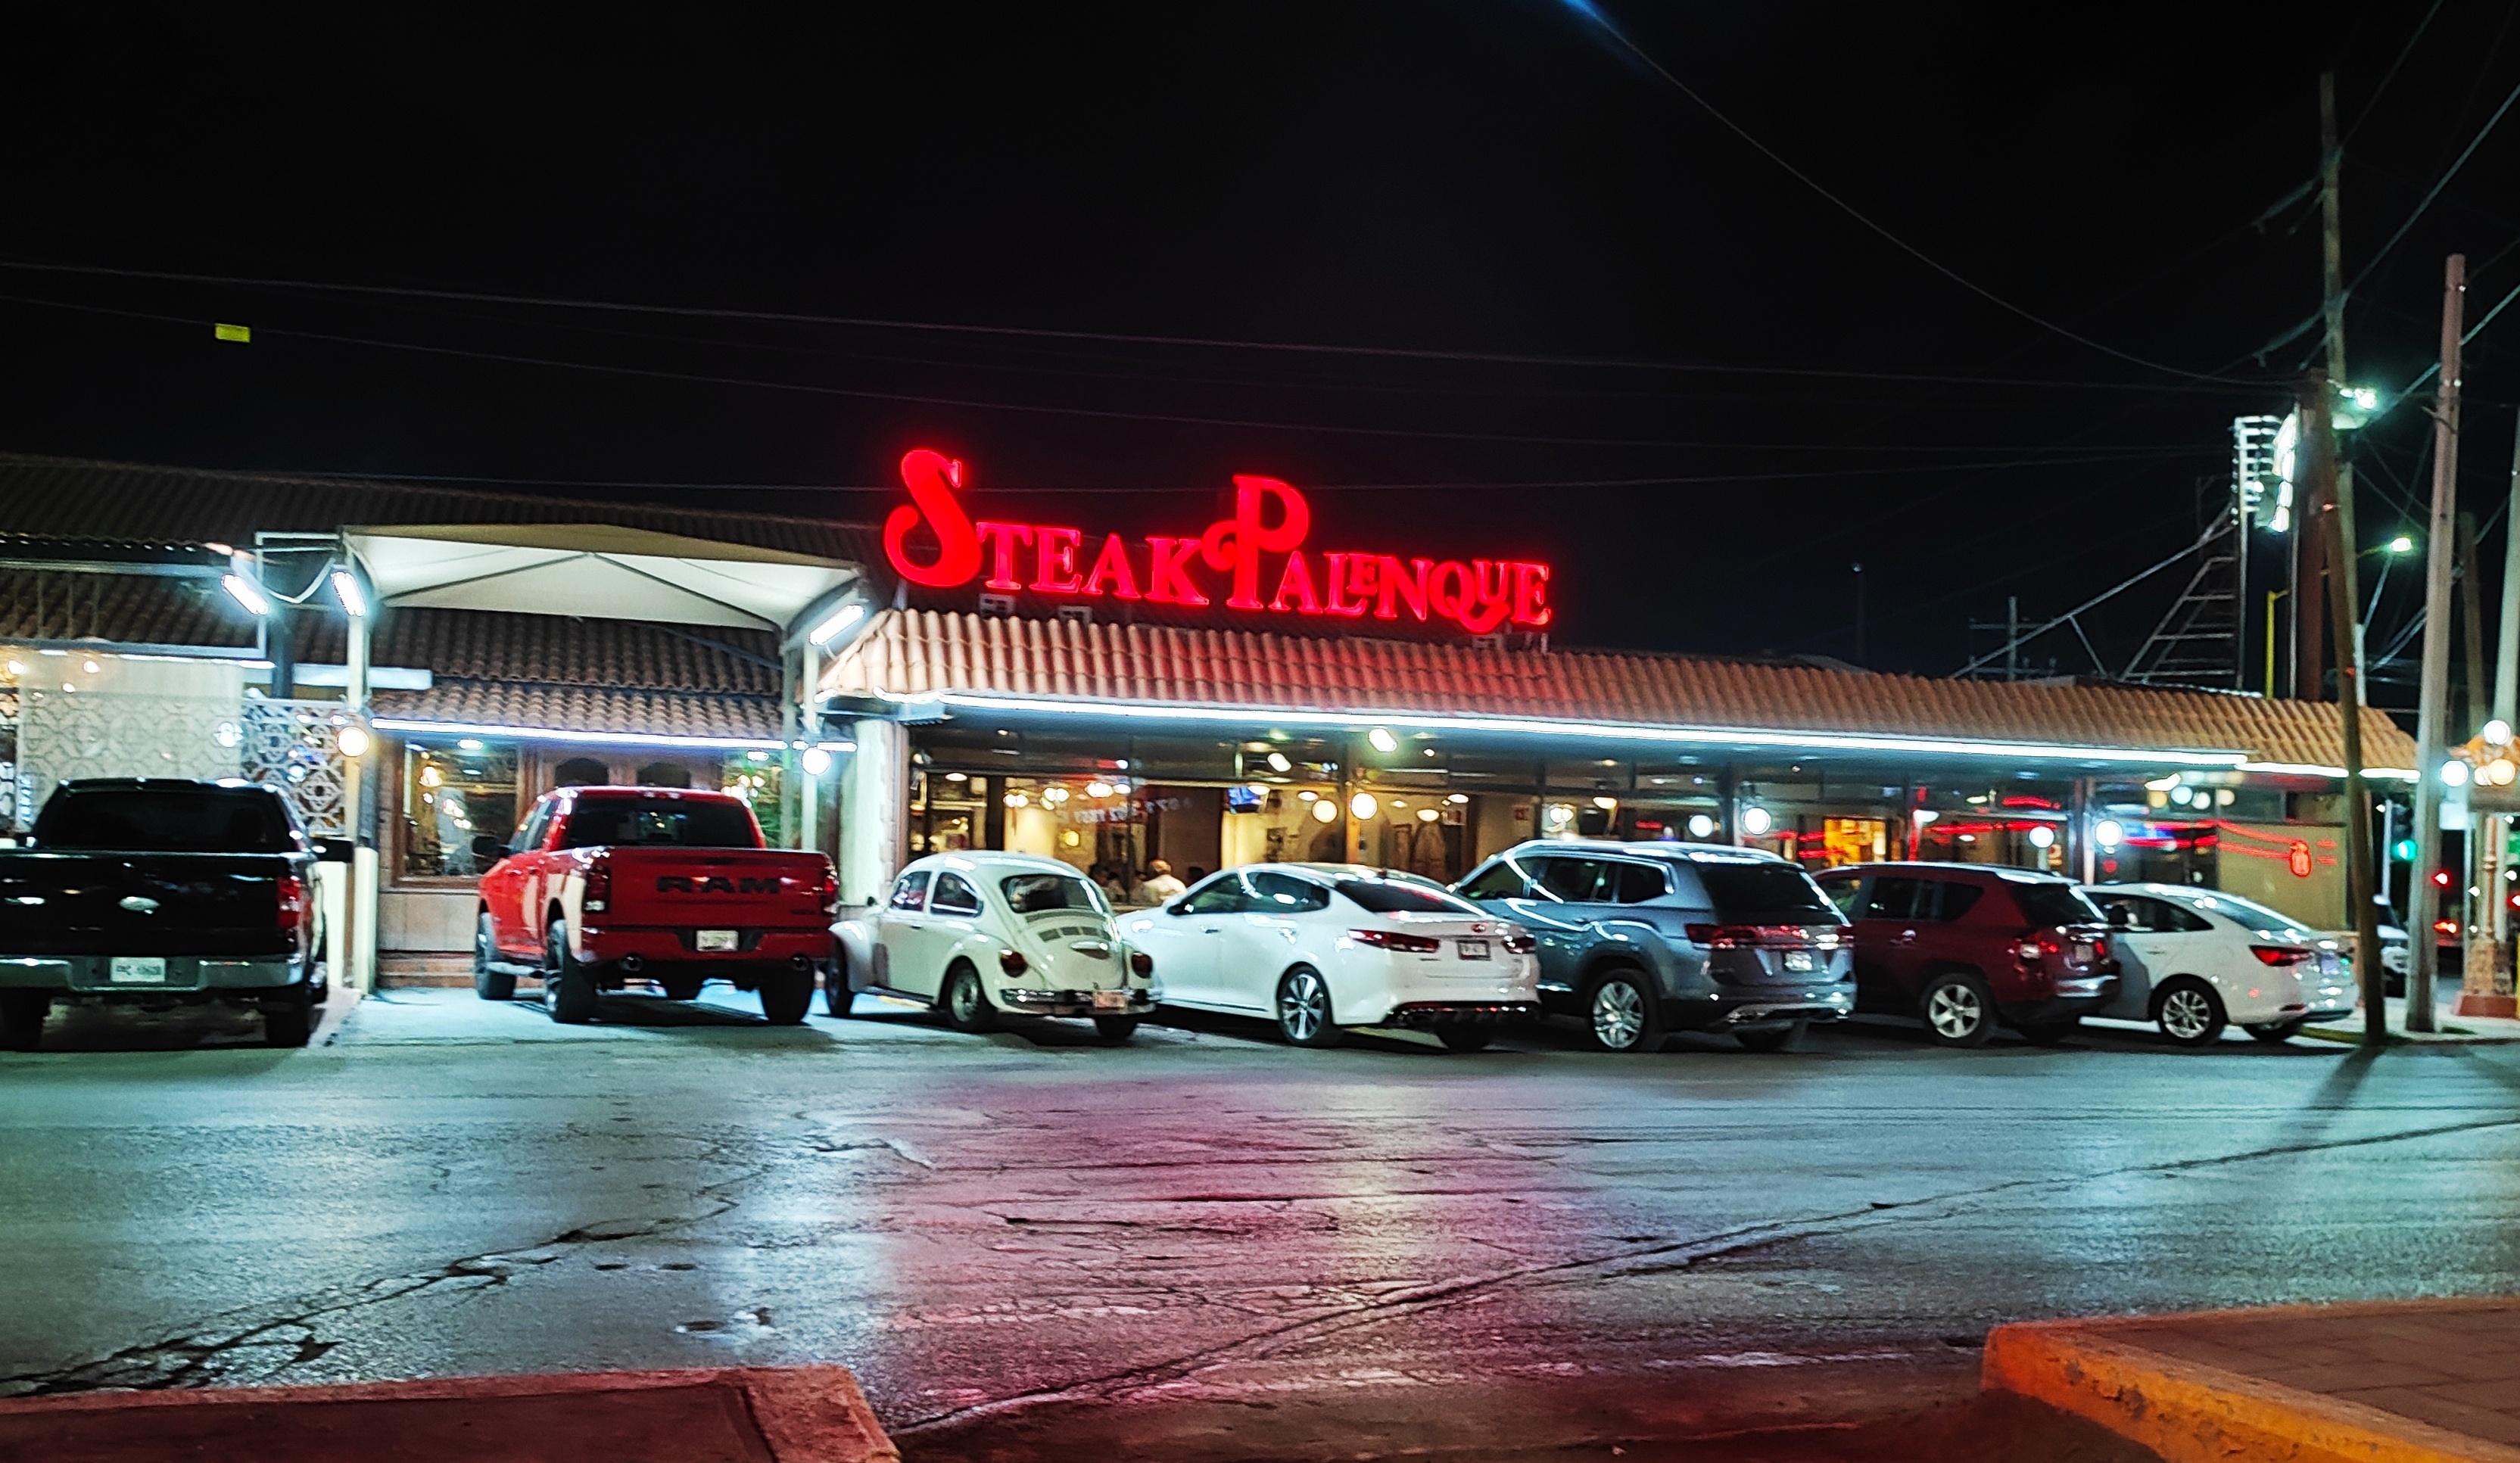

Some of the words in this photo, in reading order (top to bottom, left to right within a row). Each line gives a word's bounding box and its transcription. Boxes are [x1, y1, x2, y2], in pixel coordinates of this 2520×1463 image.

[883, 450, 1210, 605] STEAK
[1201, 475, 1550, 633] PALENQUE
[657, 876, 780, 893] RAM
